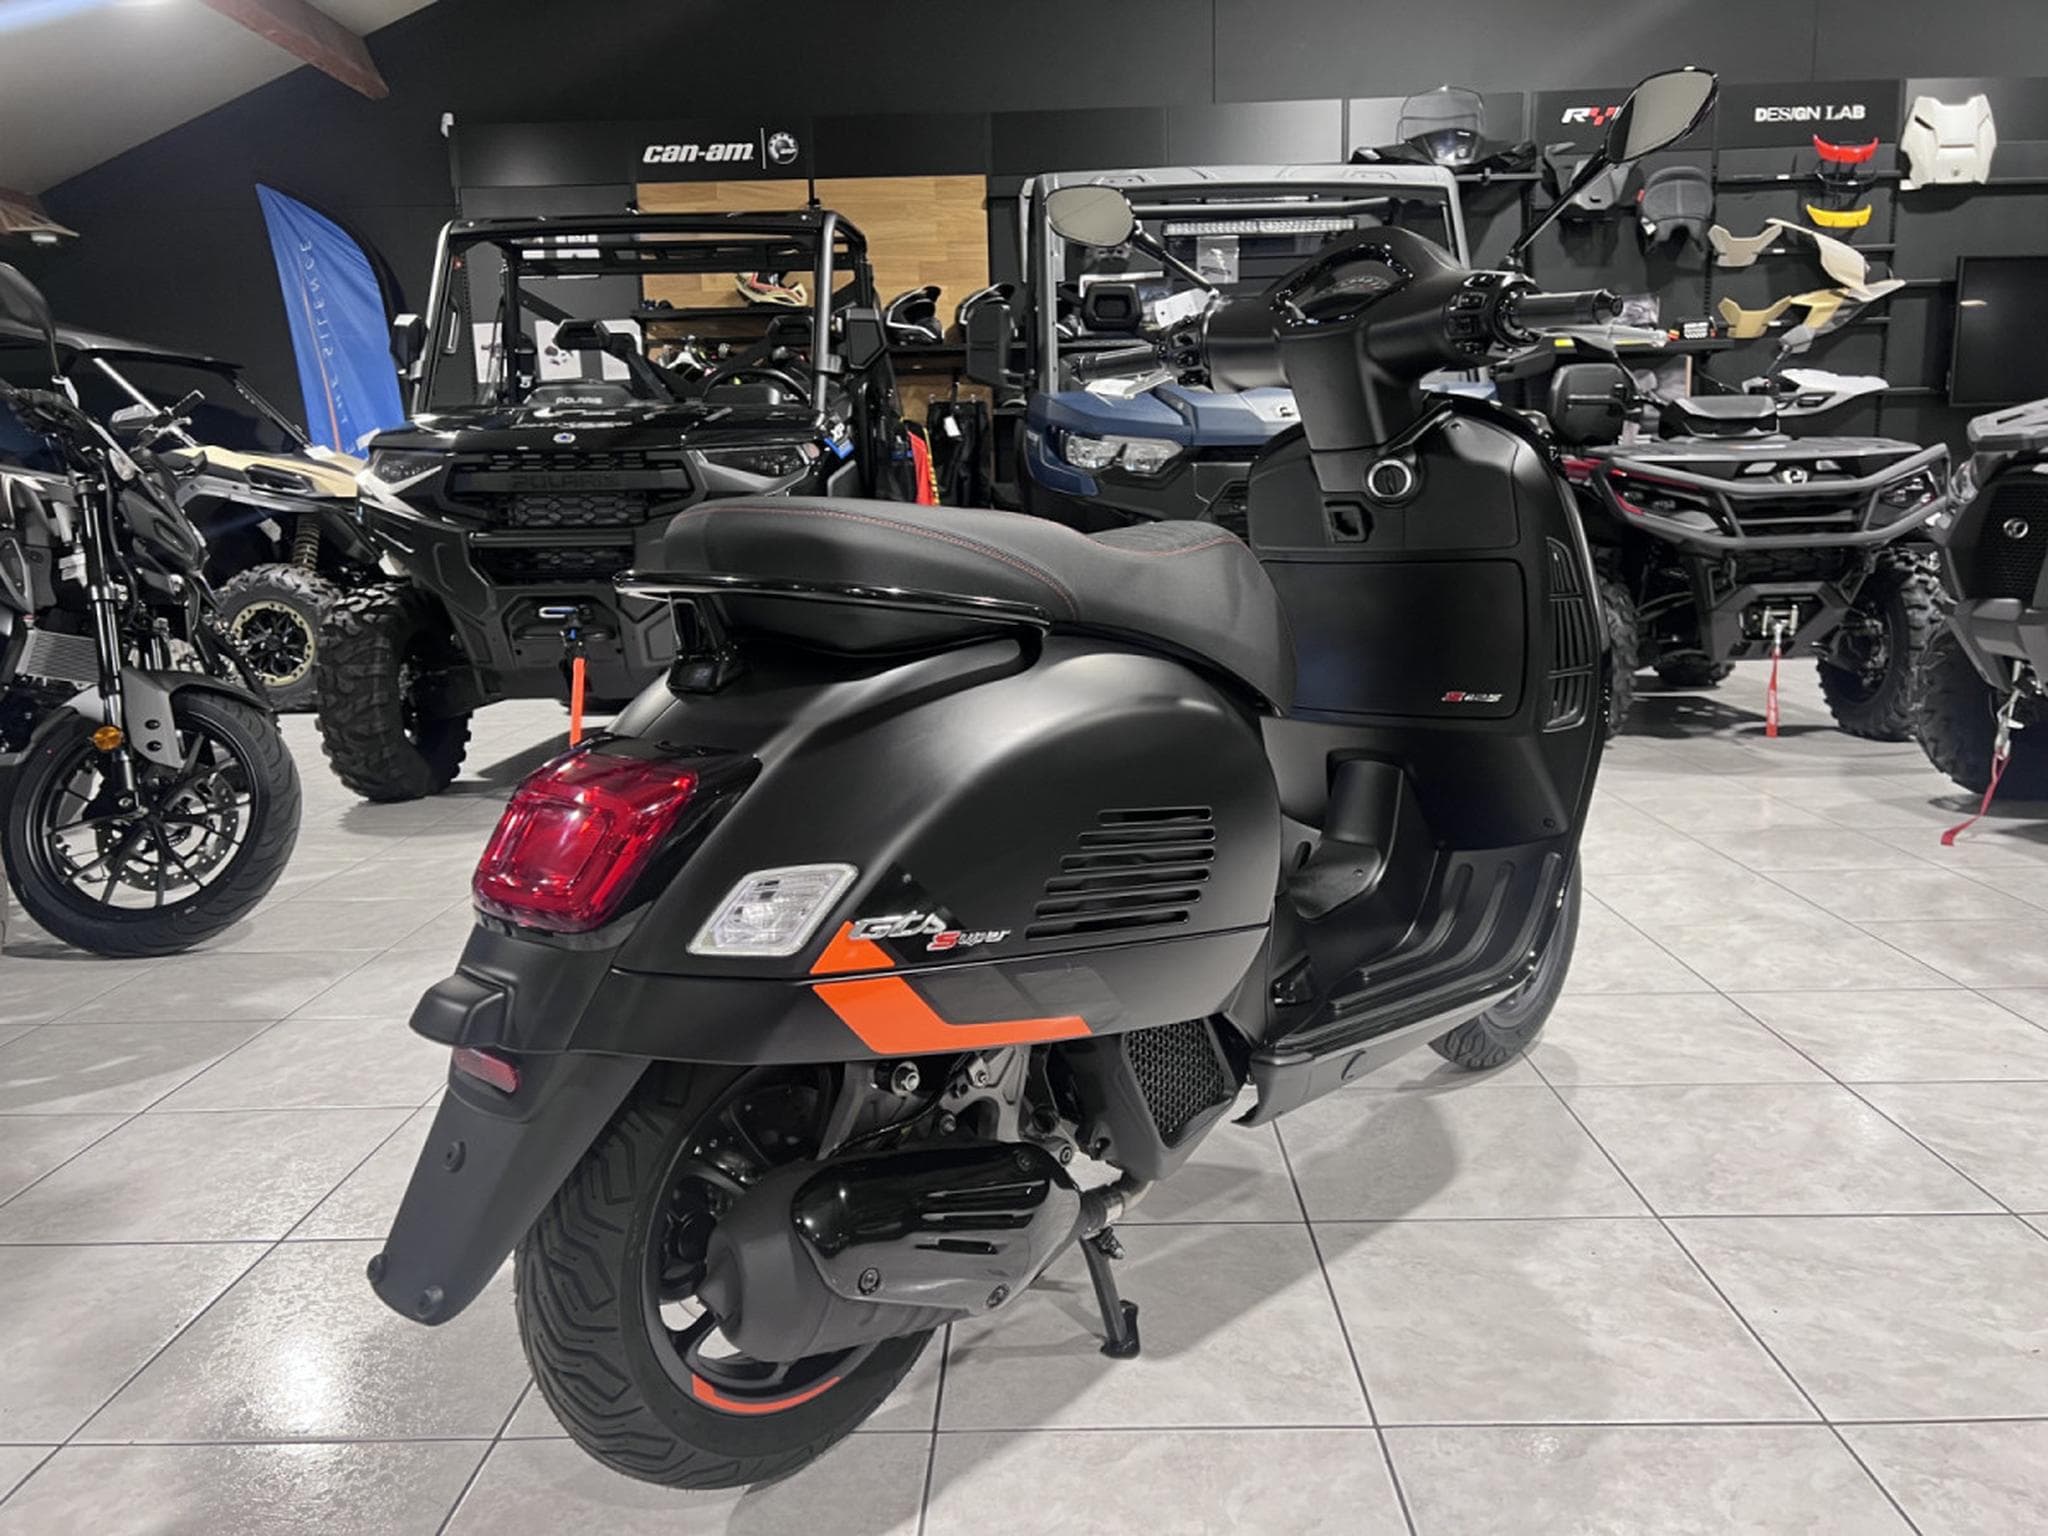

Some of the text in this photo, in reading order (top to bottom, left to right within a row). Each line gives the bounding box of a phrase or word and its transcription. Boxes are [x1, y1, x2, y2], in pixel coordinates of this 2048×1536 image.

[1755, 104, 1866, 122] DESIGN LAB
[643, 142, 754, 163] can-am
